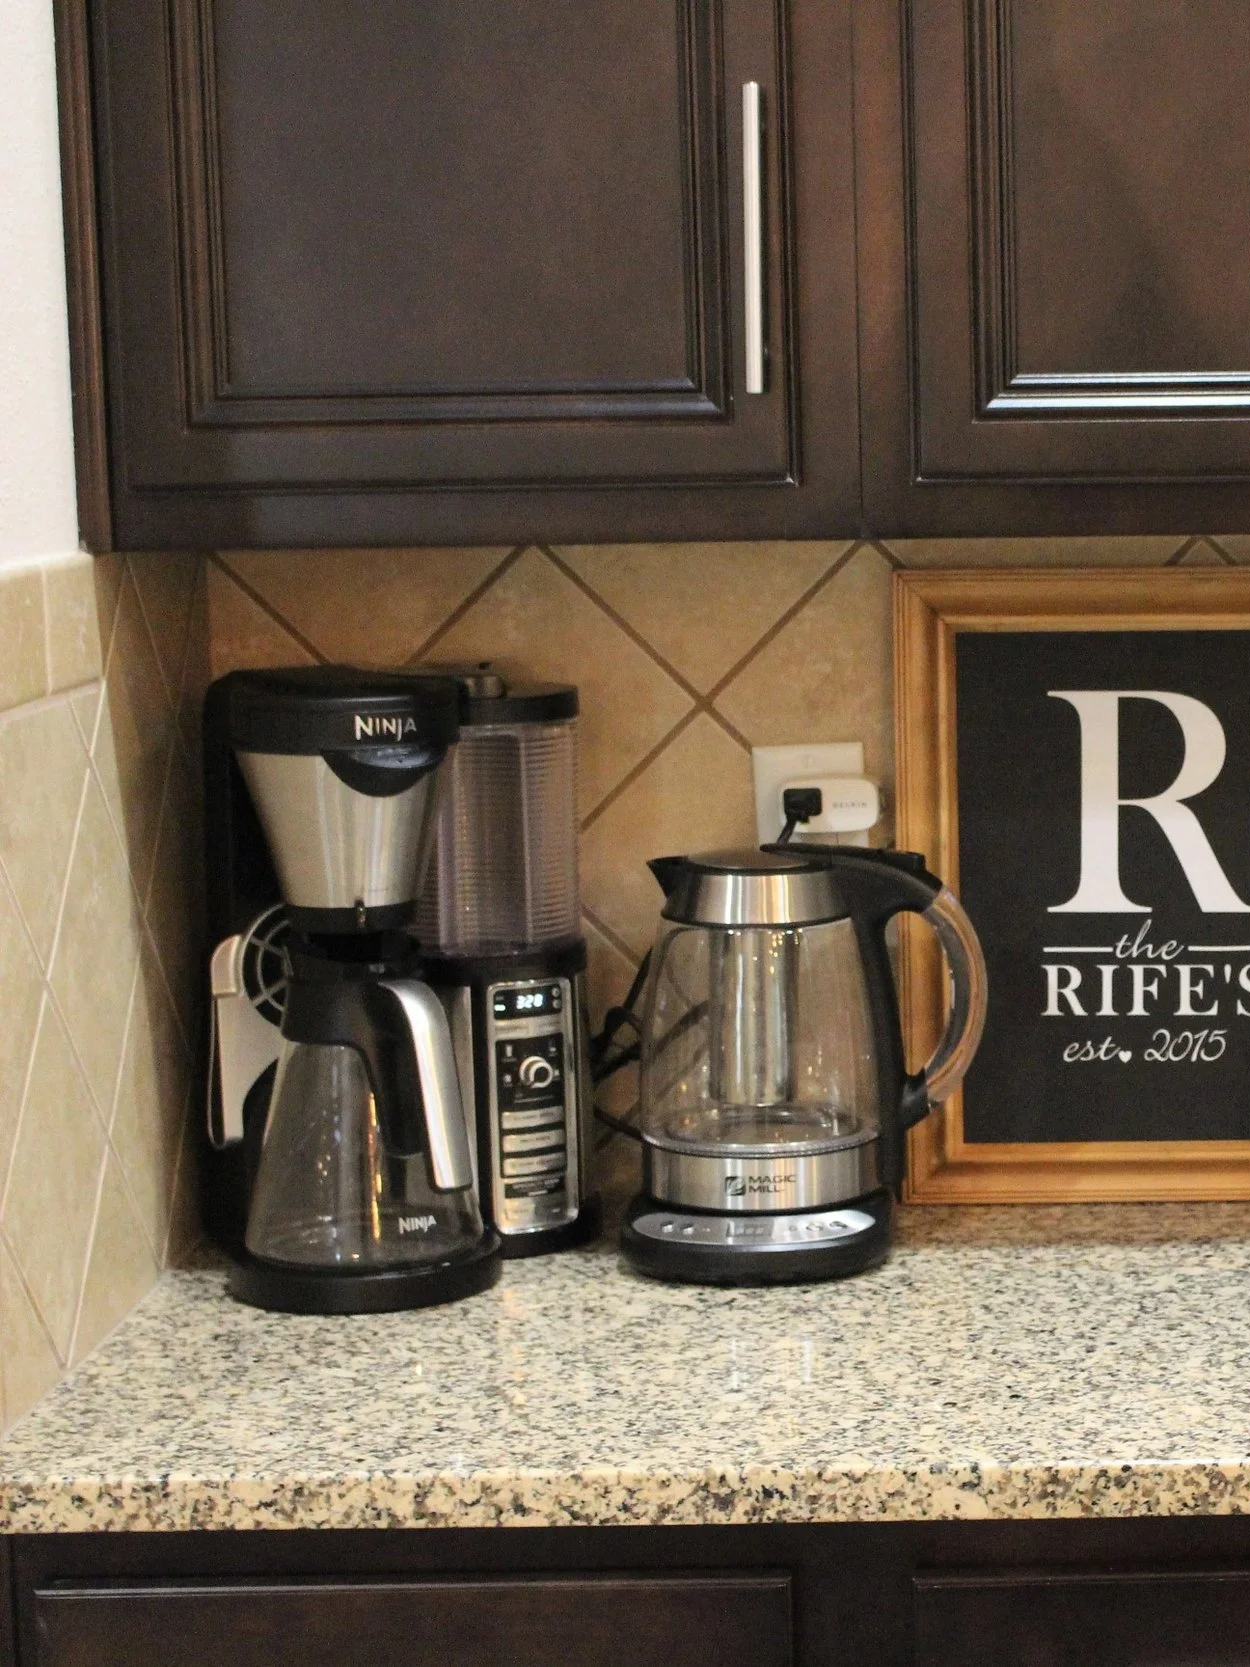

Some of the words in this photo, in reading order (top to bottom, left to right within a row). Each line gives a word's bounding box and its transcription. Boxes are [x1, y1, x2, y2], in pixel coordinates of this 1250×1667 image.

[354, 714, 417, 741] NINJA
[1115, 918, 1184, 960] the
[1144, 1028, 1228, 1062] 2015
[748, 1175, 796, 1183] MAGIC
[398, 1215, 437, 1235] NINJA
